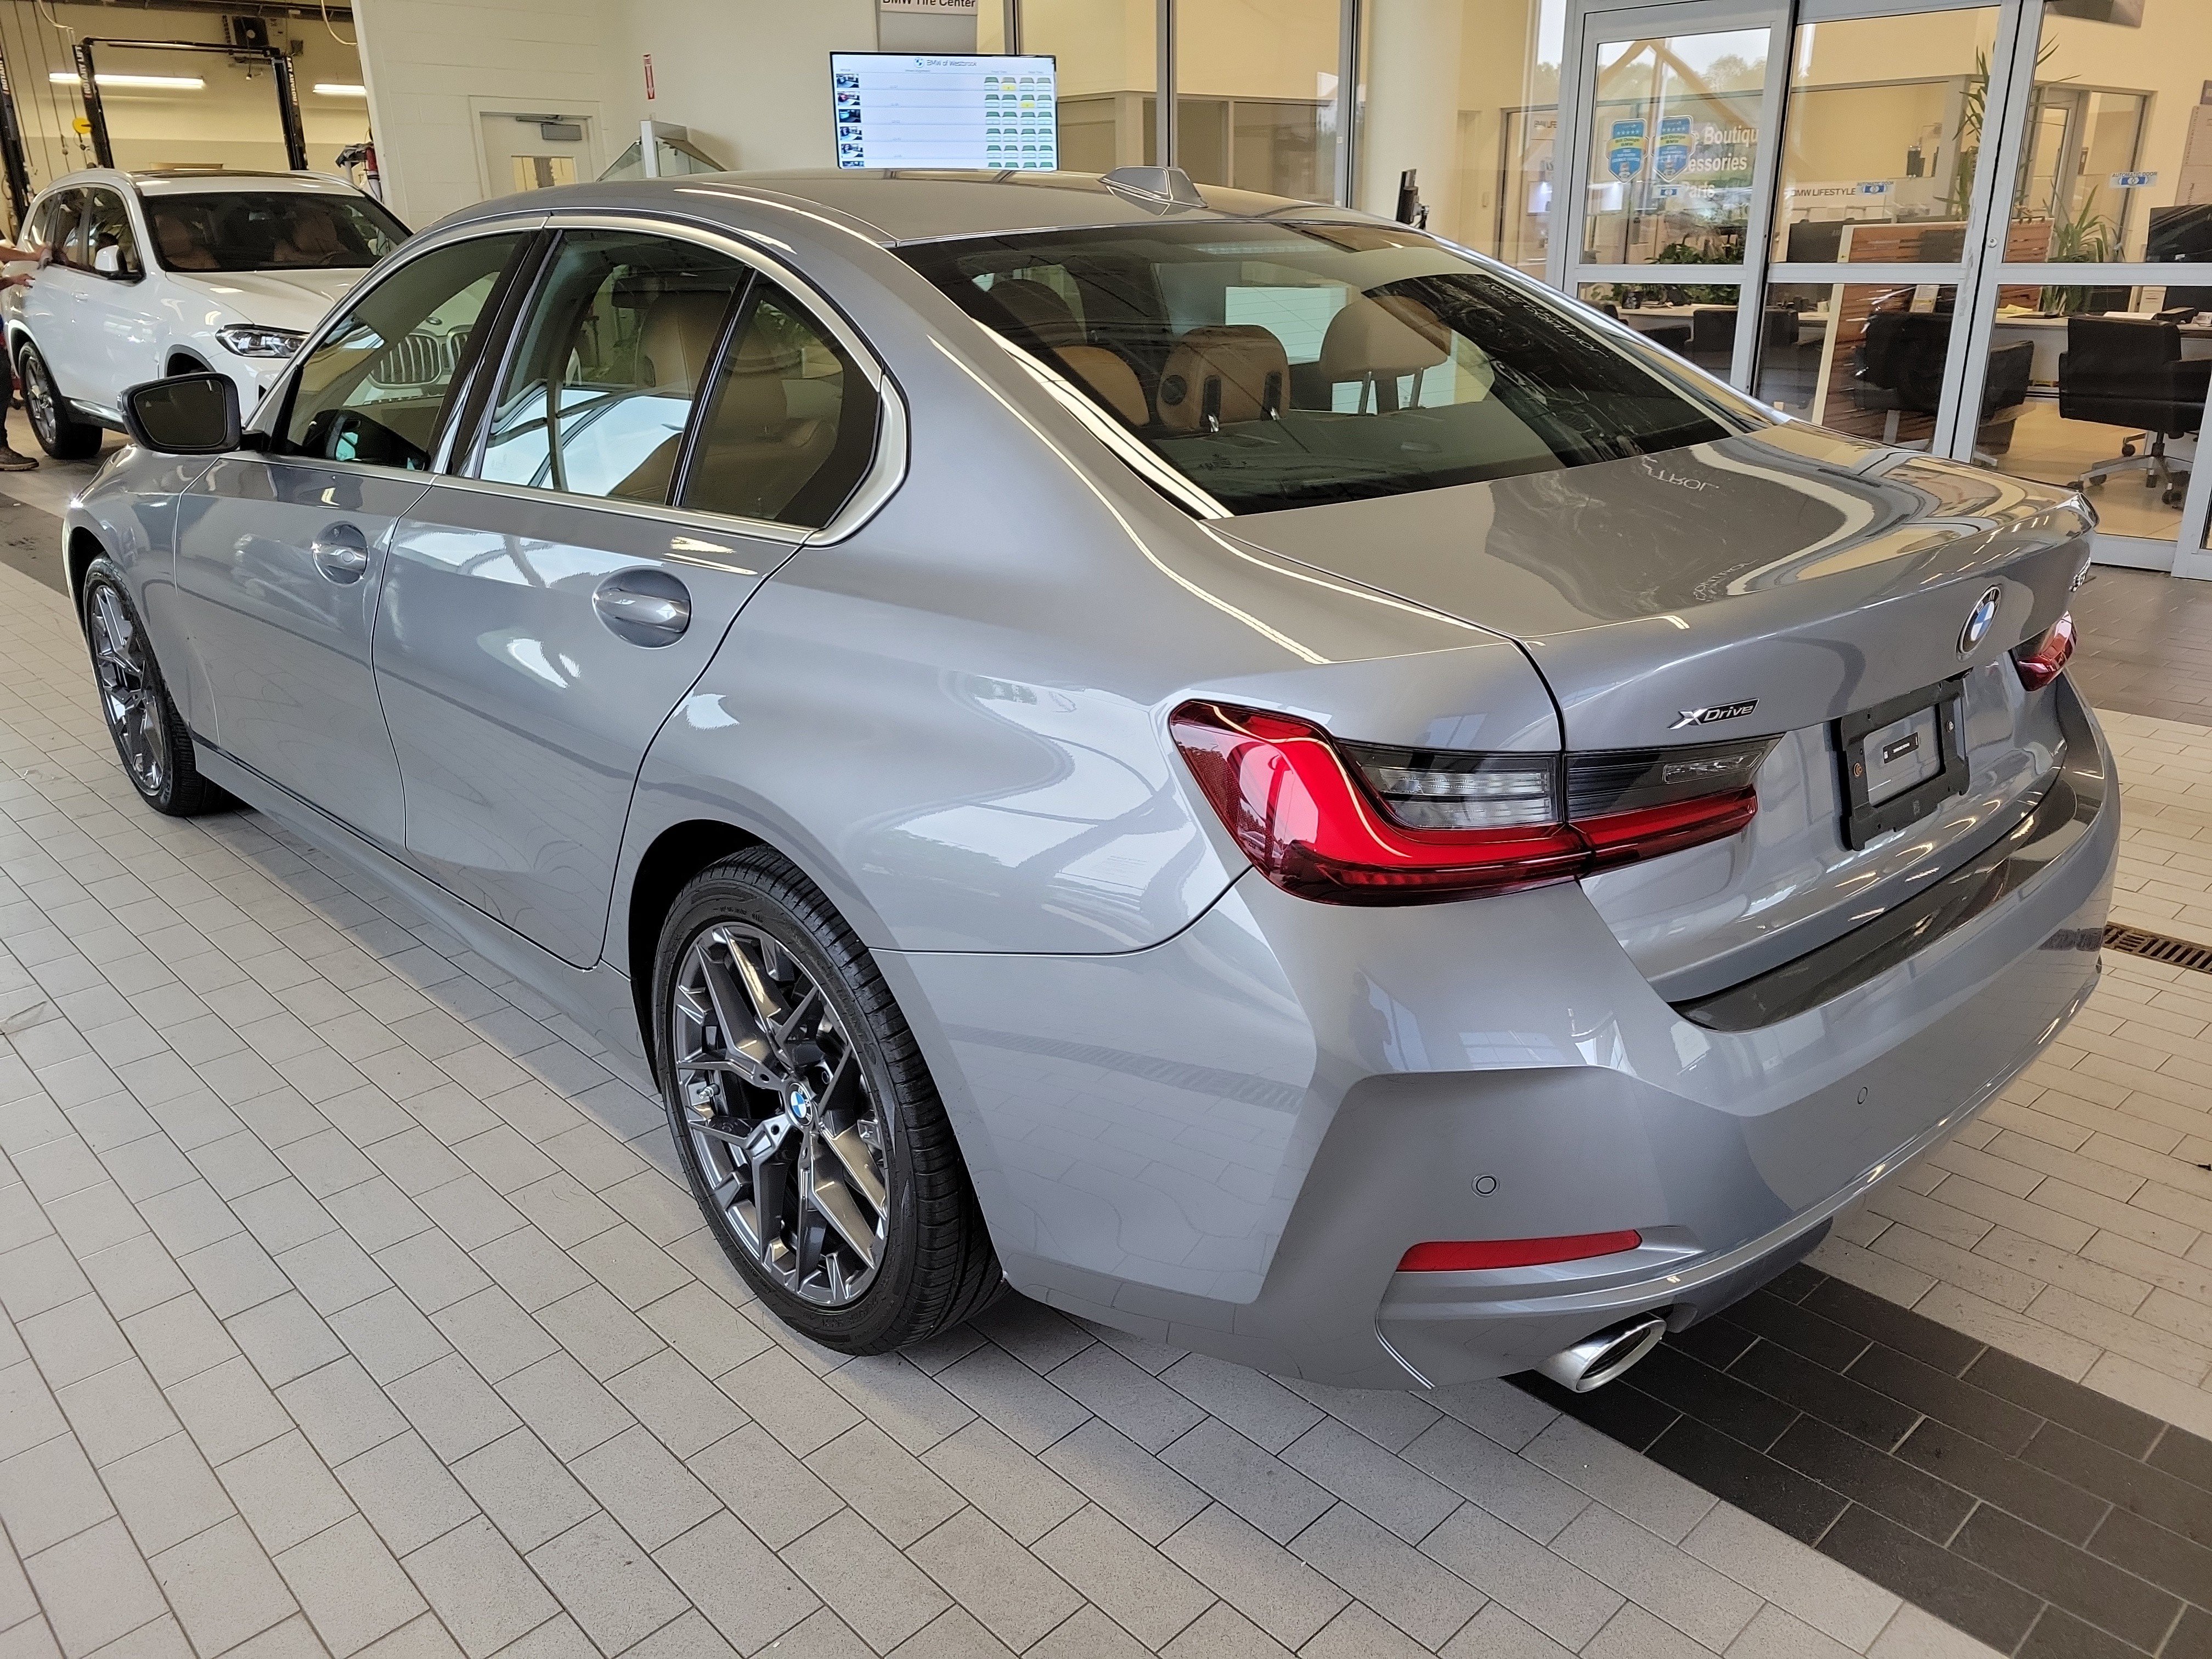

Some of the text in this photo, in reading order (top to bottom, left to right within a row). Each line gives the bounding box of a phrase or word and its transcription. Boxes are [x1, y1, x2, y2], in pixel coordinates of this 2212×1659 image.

[75, 46, 83, 63] LIFT
[289, 72, 298, 101] ROTARY
[1812, 188, 1856, 196] LIFESTYLE
